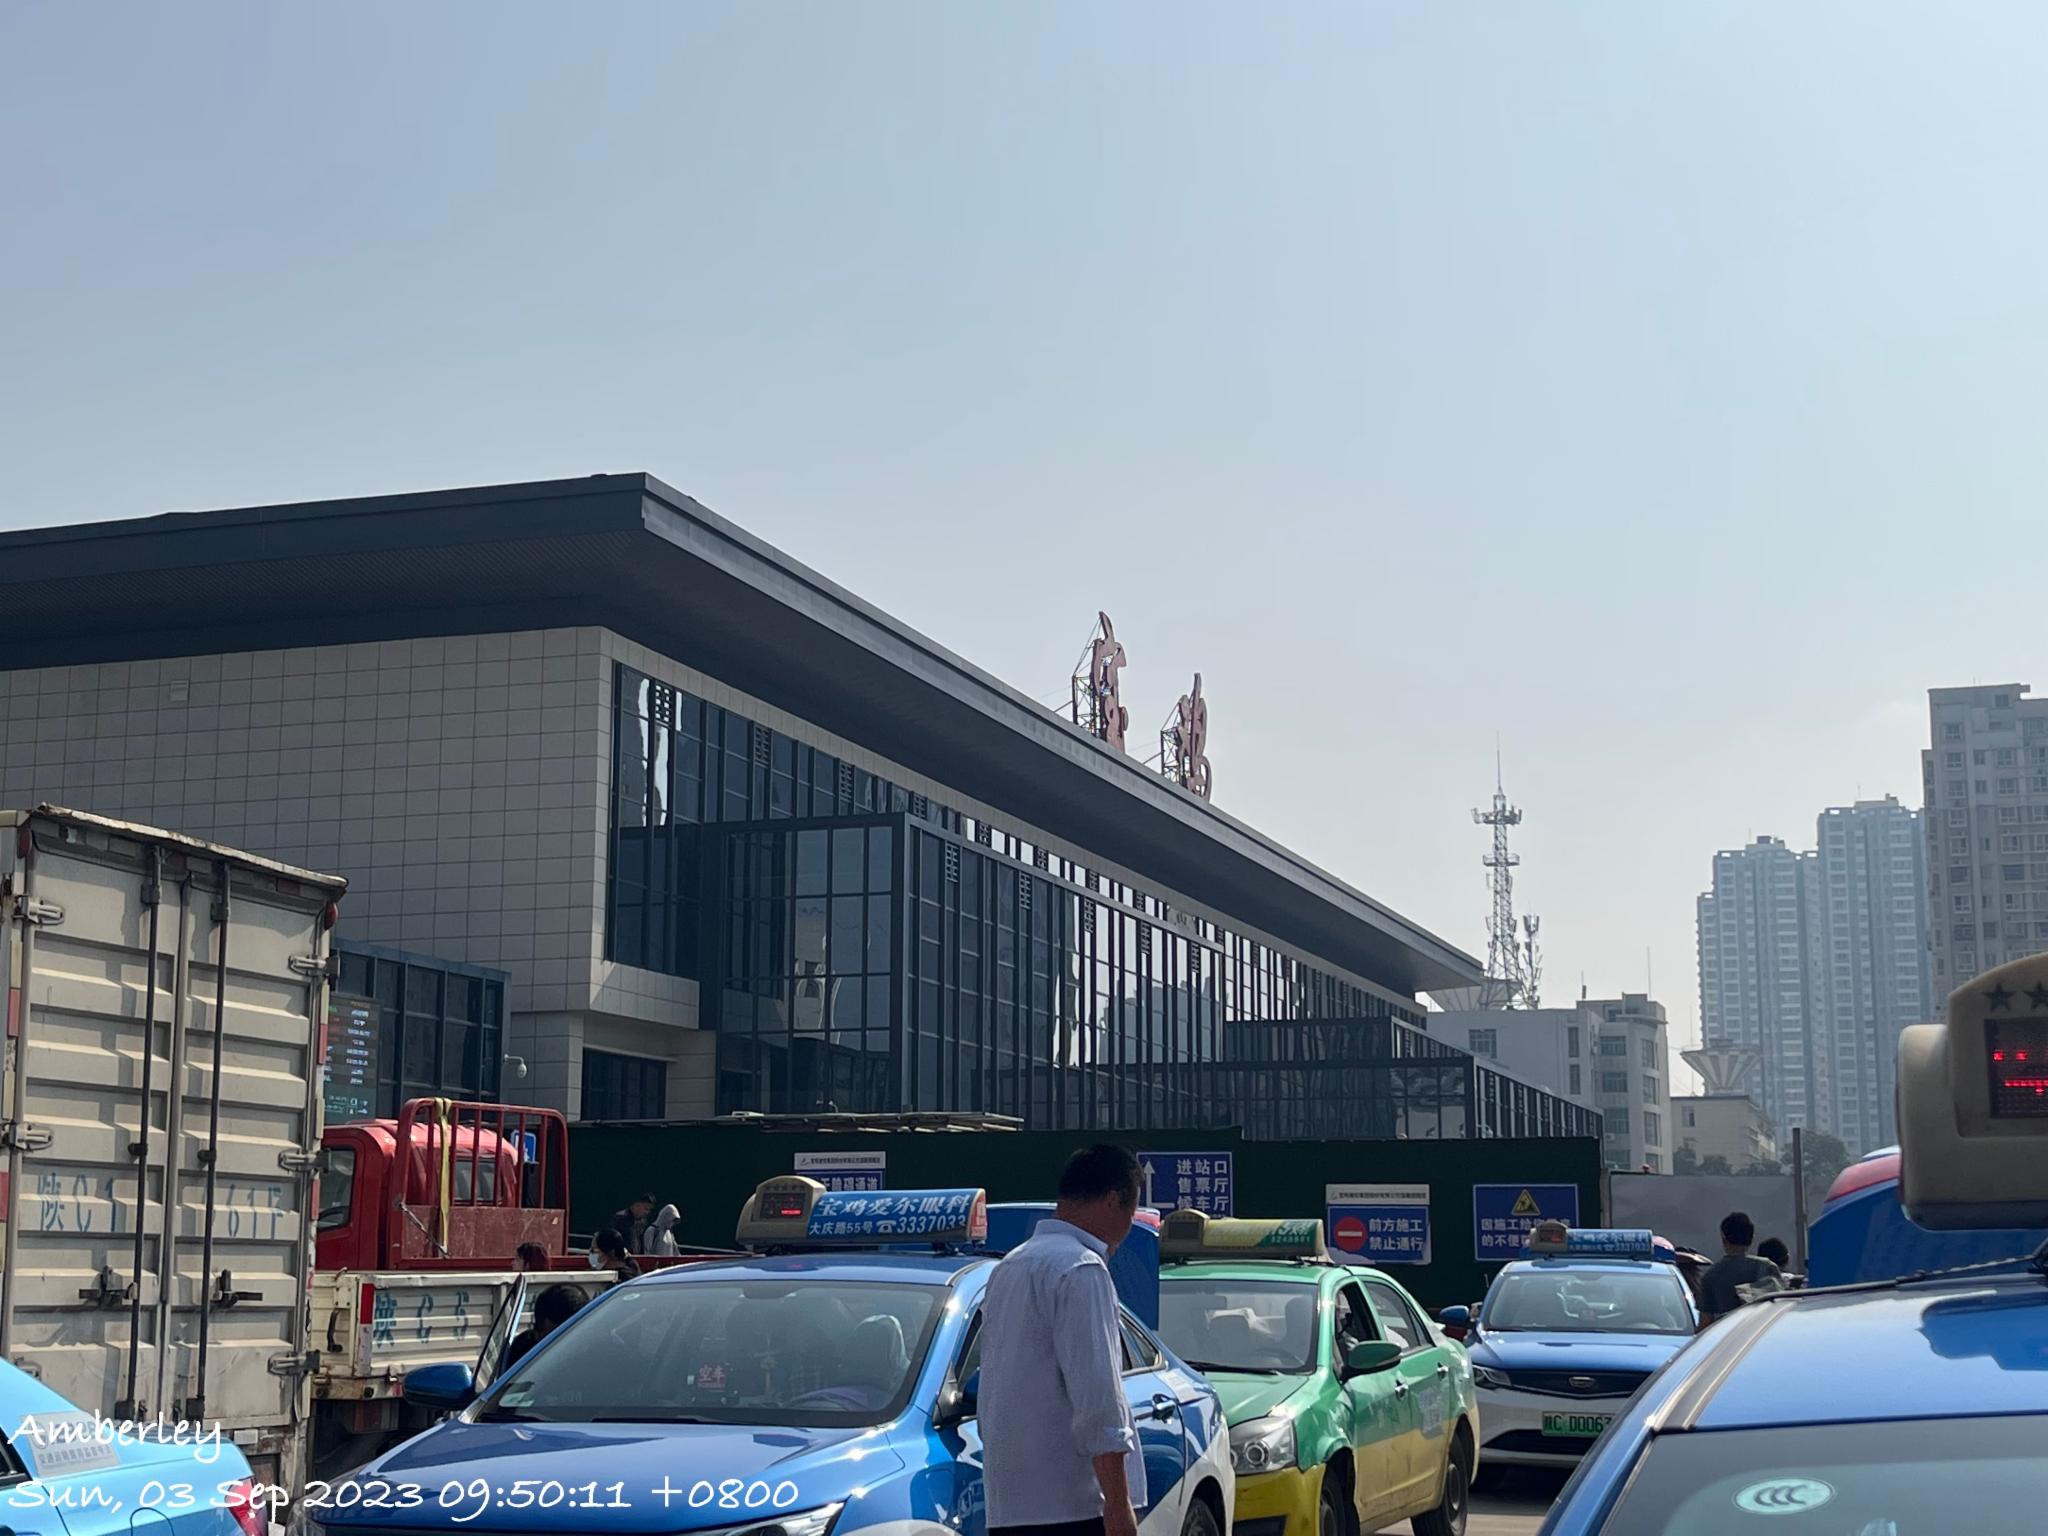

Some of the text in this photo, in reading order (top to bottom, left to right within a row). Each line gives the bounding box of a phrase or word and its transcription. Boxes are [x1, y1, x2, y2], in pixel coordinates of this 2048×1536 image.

[1176, 1157, 1228, 1176] 进站口
[1177, 1176, 1229, 1194] 售票厅
[813, 1193, 971, 1218] 宝鸡爱尔眼科
[1177, 1194, 1230, 1211] 候车厅
[808, 1220, 874, 1237] 大庆路55号
[896, 1214, 967, 1235] 3337033
[1368, 1217, 1424, 1233] 前方施工
[1369, 1235, 1425, 1252] 禁止通行
